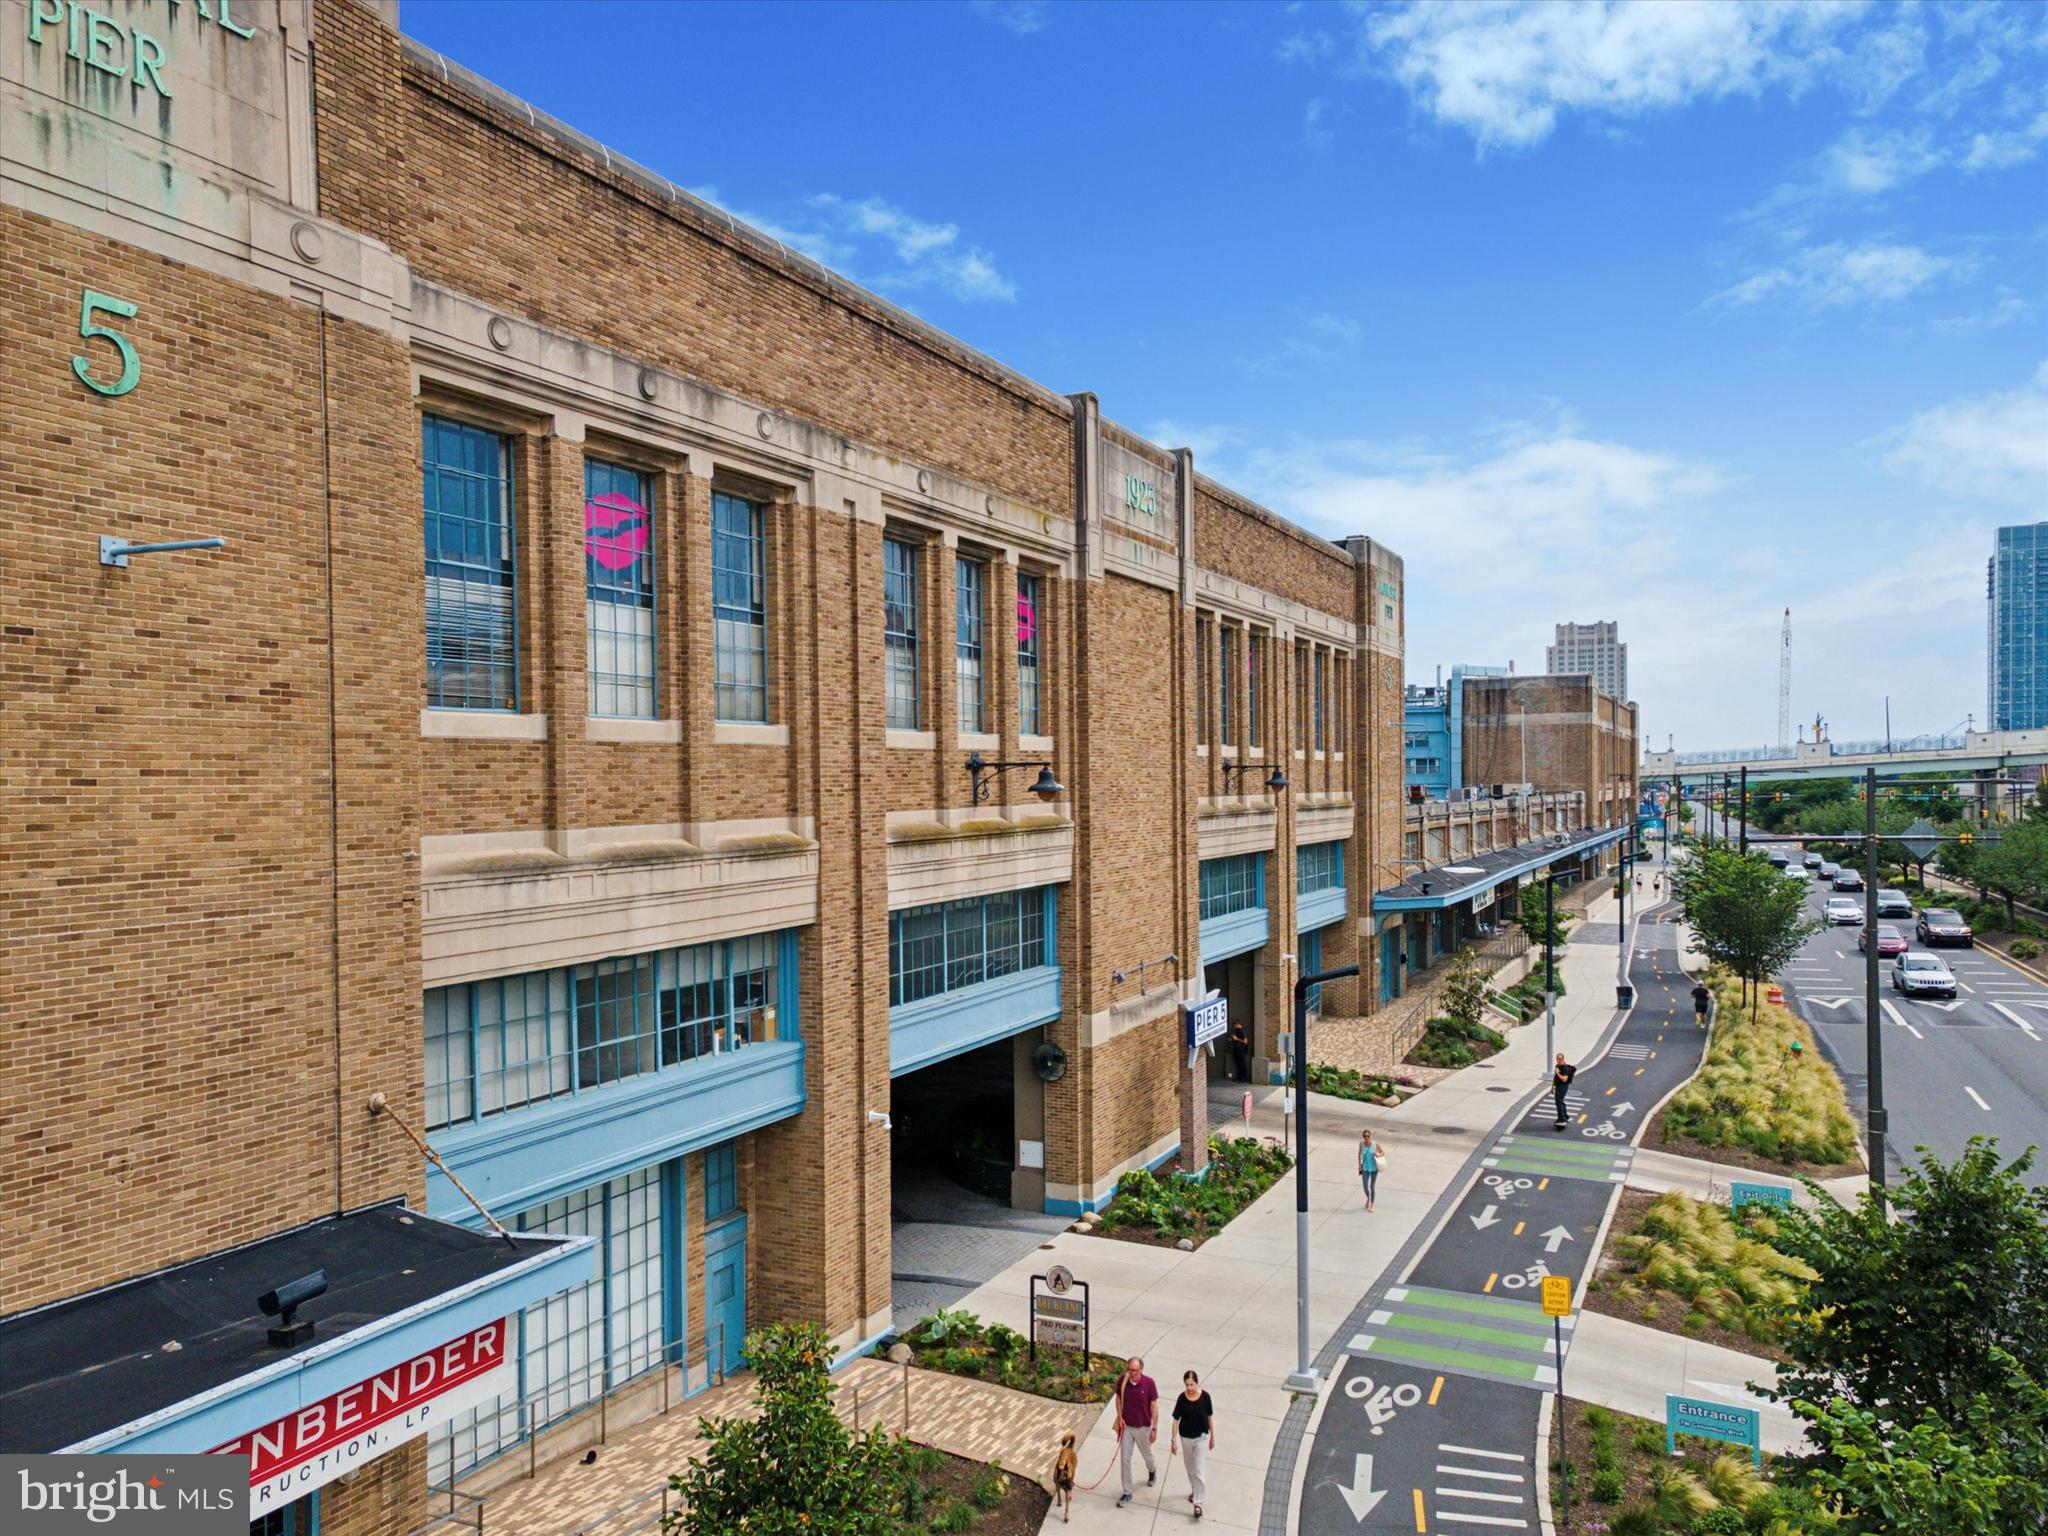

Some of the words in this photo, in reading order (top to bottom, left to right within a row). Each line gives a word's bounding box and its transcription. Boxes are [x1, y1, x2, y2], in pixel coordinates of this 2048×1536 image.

[28, 0, 174, 98] PIER
[72, 289, 141, 396] 5
[1196, 1006, 1219, 1033] PIER
[1220, 1003, 1226, 1021] 5
[1739, 1189, 1759, 1199] Exit
[1761, 1191, 1784, 1202] Only
[213, 1325, 498, 1472] NBENDER
[1678, 1403, 1747, 1425] Entrance
[250, 1431, 389, 1503] RUCTION,
[405, 1406, 430, 1428] LP
